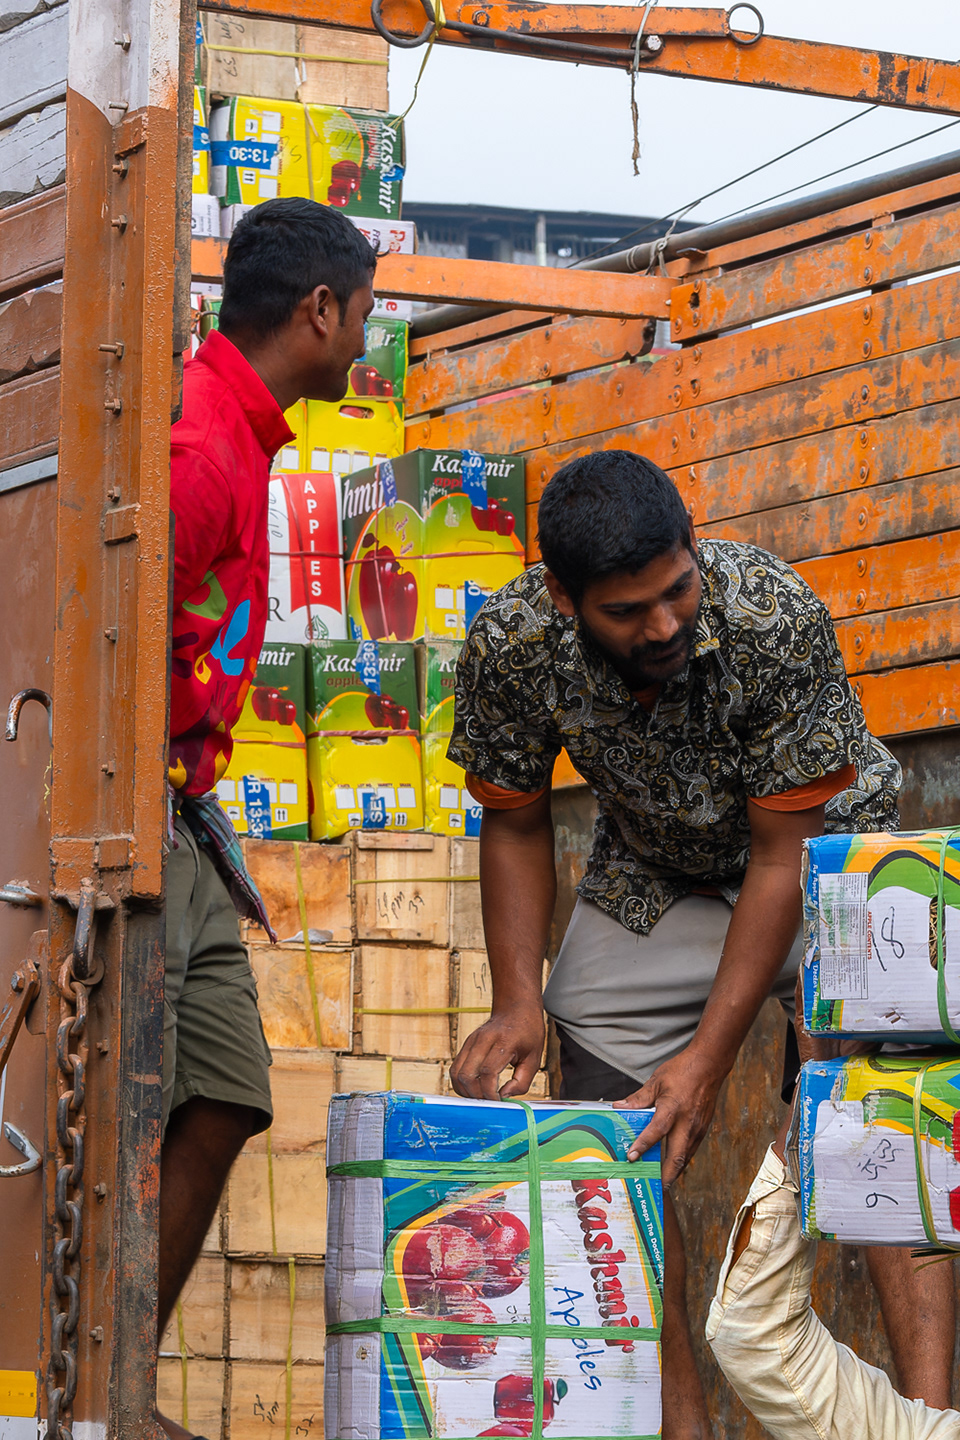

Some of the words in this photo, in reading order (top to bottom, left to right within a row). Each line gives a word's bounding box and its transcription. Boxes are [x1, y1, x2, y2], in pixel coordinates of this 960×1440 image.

[229, 146, 270, 164] 13:30
[434, 477, 463, 488] appl
[326, 673, 362, 688] apple
[635, 1183, 644, 1199] Day
[640, 1200, 650, 1222] Keeps
[645, 1222, 655, 1236] The
[650, 1237, 662, 1261] Doctor
